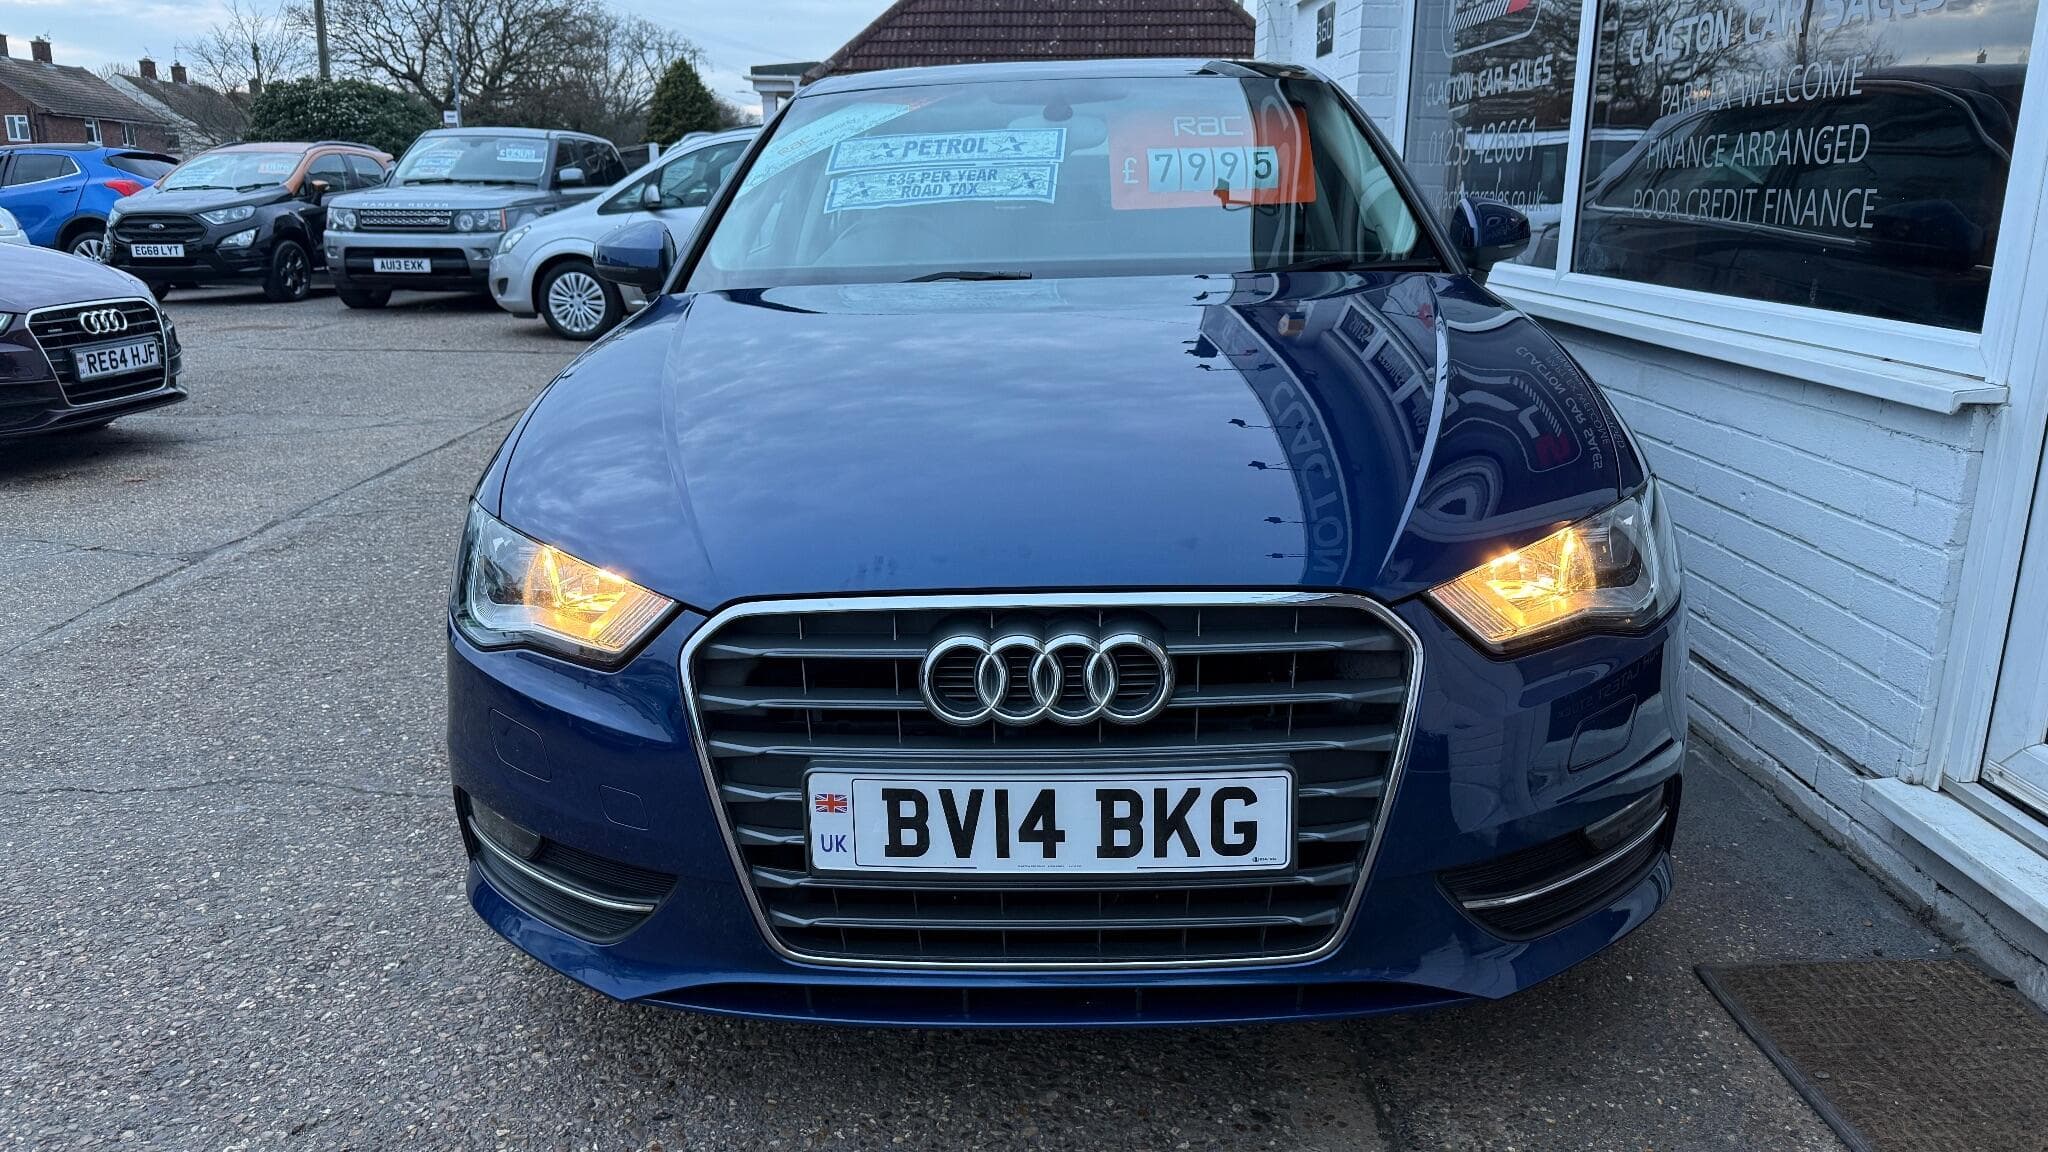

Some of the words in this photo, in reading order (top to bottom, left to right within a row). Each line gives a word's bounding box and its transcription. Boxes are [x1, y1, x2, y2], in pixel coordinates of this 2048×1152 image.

[1317, 17, 1332, 44] 360
[1629, 7, 1733, 66] CLACTON
[1426, 72, 1474, 107] CLACTON
[1478, 66, 1504, 97] CAR
[1508, 54, 1553, 92] SALES
[1659, 79, 1703, 117] PART
[1709, 75, 1735, 110] EX
[1741, 54, 1867, 108] WELCOME
[902, 137, 990, 158] PETROL
[1428, 127, 1472, 167] 01255
[1475, 117, 1537, 164] 426661
[1646, 133, 1728, 169] FINANCE
[1730, 123, 1870, 167] ARRANGED
[887, 173, 915, 186] £35
[920, 170, 951, 184] PER
[955, 168, 998, 182] YEAR
[901, 185, 943, 198] ROAD
[949, 182, 980, 196] TAX
[1632, 188, 1680, 220] POOR
[1686, 188, 1760, 223] CREDIT
[1763, 188, 1878, 229] FINANCE
[135, 245, 159, 256] EG68
[161, 245, 179, 256] LYT
[380, 258, 403, 271] AU13
[404, 258, 424, 271] EXK
[86, 351, 128, 374] RE64
[131, 343, 156, 367] HJF
[881, 787, 1066, 859] BV14
[1095, 786, 1259, 859] BKG
[820, 833, 848, 853] UK
